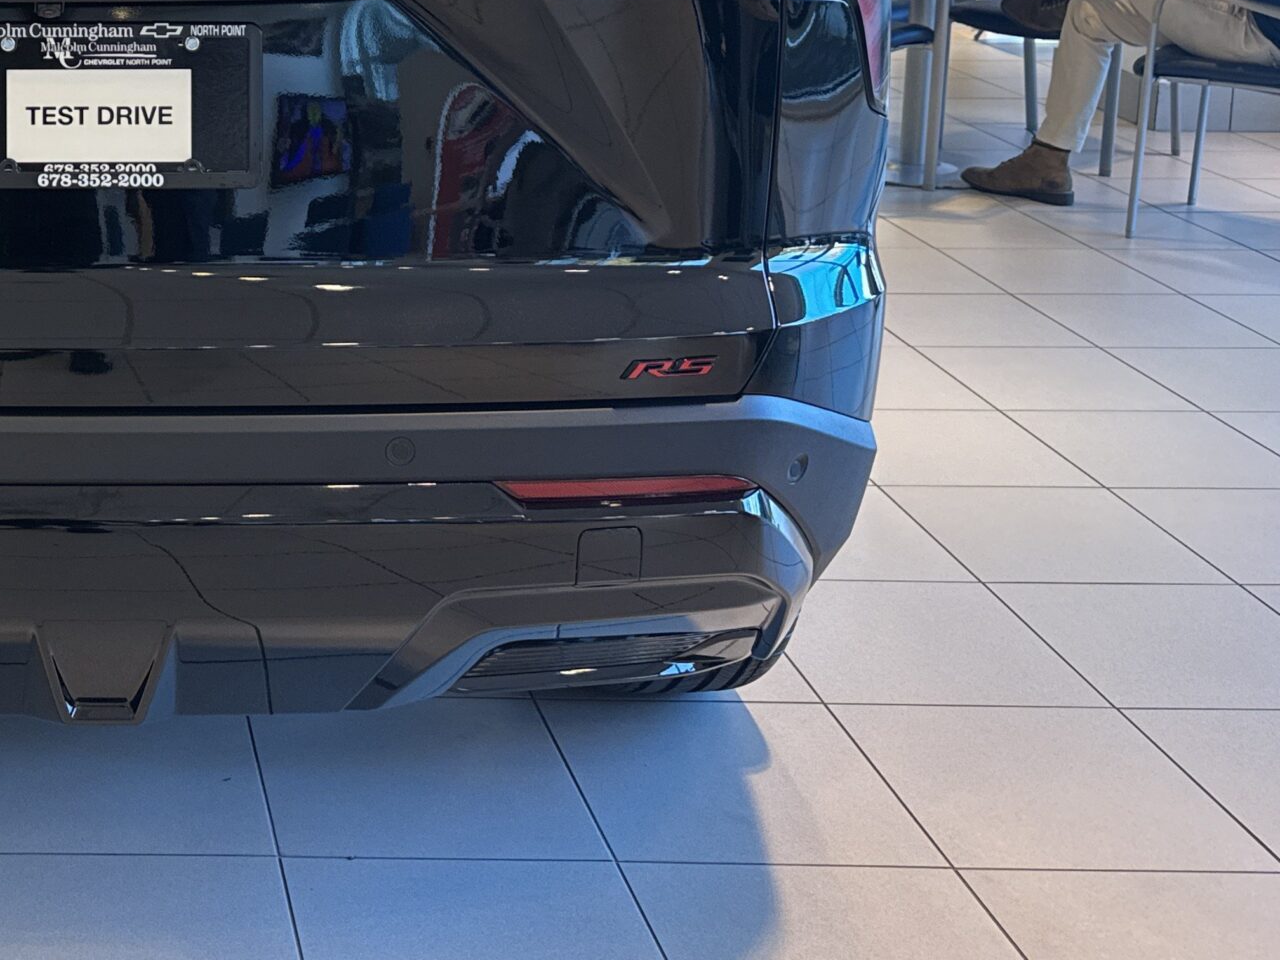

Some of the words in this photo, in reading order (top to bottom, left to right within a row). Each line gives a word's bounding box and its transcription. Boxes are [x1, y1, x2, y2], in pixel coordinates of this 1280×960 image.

[29, 23, 134, 40] Cunningham
[190, 24, 220, 37] NORTH
[221, 24, 247, 37] POINT
[40, 41, 87, 53] Malcolm
[88, 41, 157, 54] Cunningham
[83, 58, 125, 66] CHEVROLET
[126, 58, 150, 66] NORTH
[151, 58, 173, 66] POINT
[25, 105, 89, 126] TEST
[97, 105, 173, 126] DRIVE
[37, 173, 164, 188] 678-352-2000
[620, 354, 718, 380] RS
